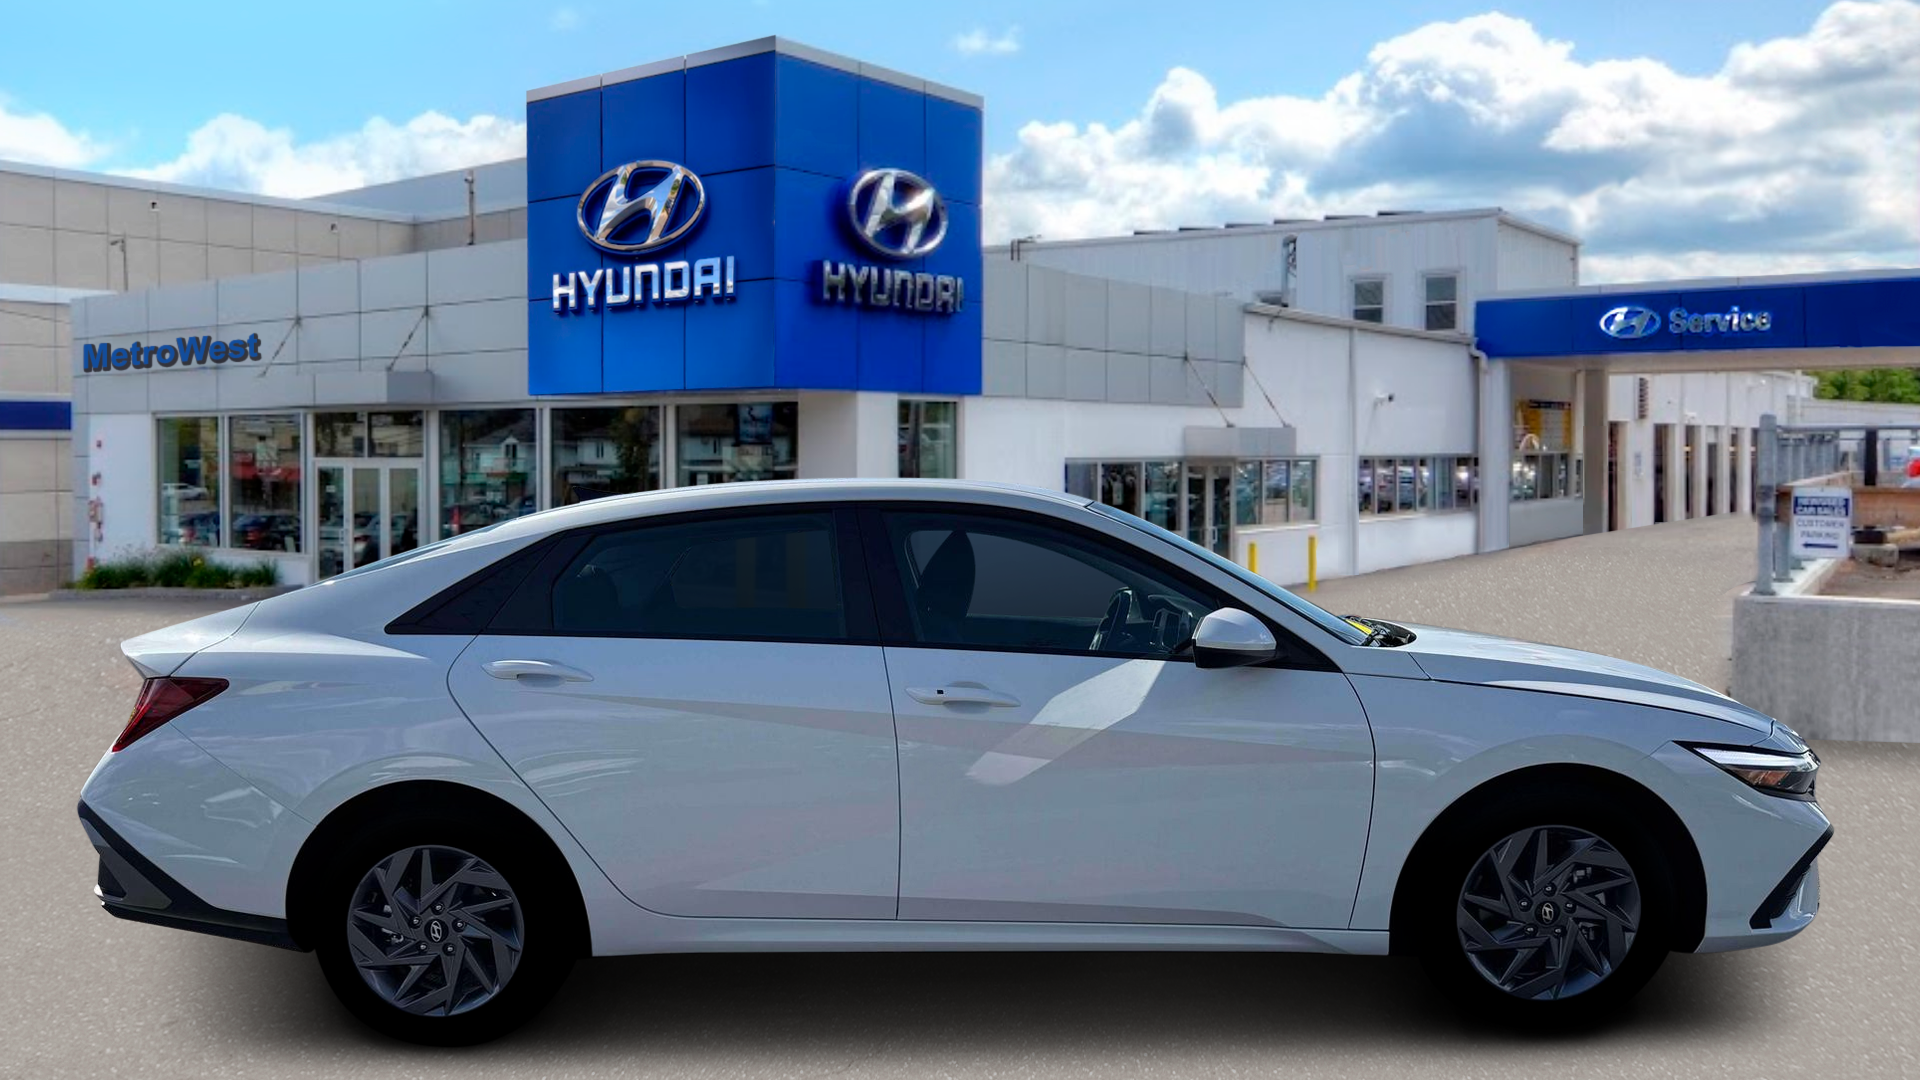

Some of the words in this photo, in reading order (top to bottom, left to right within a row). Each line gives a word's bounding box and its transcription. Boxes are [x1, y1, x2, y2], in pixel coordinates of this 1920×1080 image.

[552, 255, 735, 311] HYUNDAI
[822, 259, 964, 314] HYUNDAI
[1669, 306, 1772, 334] Service
[83, 333, 262, 372] MetroWest
